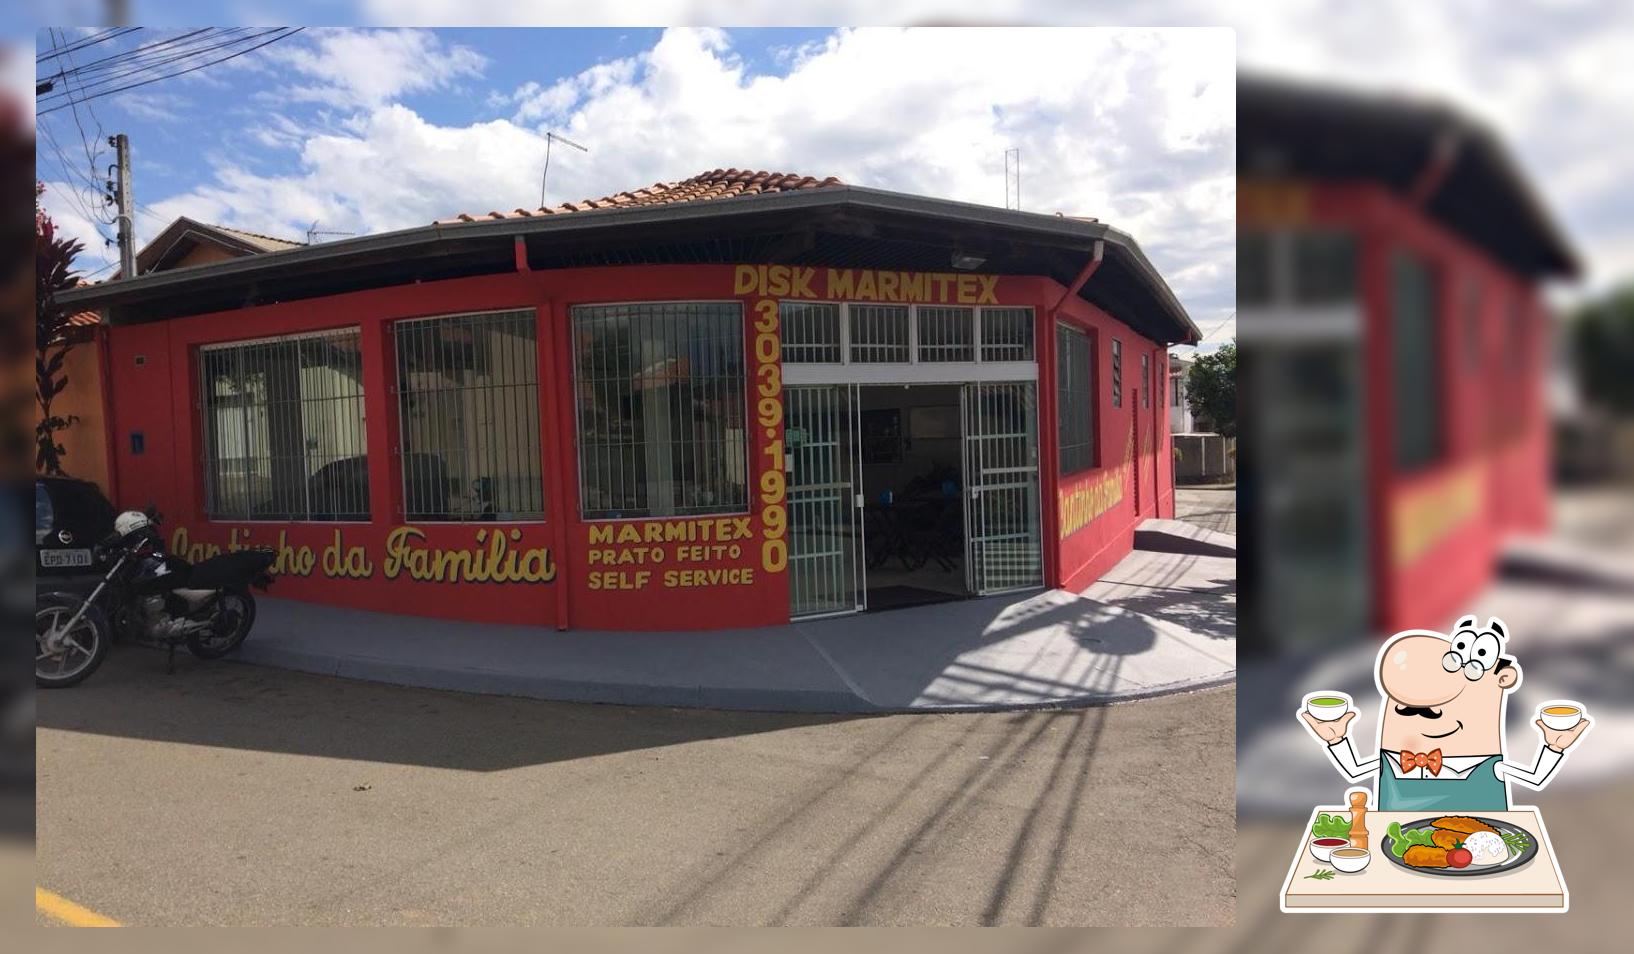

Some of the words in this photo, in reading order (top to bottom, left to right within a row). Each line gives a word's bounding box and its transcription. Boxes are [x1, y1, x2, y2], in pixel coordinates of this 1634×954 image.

[734, 265, 816, 298] DISK
[827, 269, 999, 304] MARMITEX
[588, 518, 753, 545] MARMITEX
[322, 529, 372, 578] da
[384, 526, 556, 583] Família
[588, 548, 665, 565] PRATO
[677, 544, 741, 562] FEITO
[588, 571, 651, 590] SELF
[664, 568, 754, 588] SERVICE
